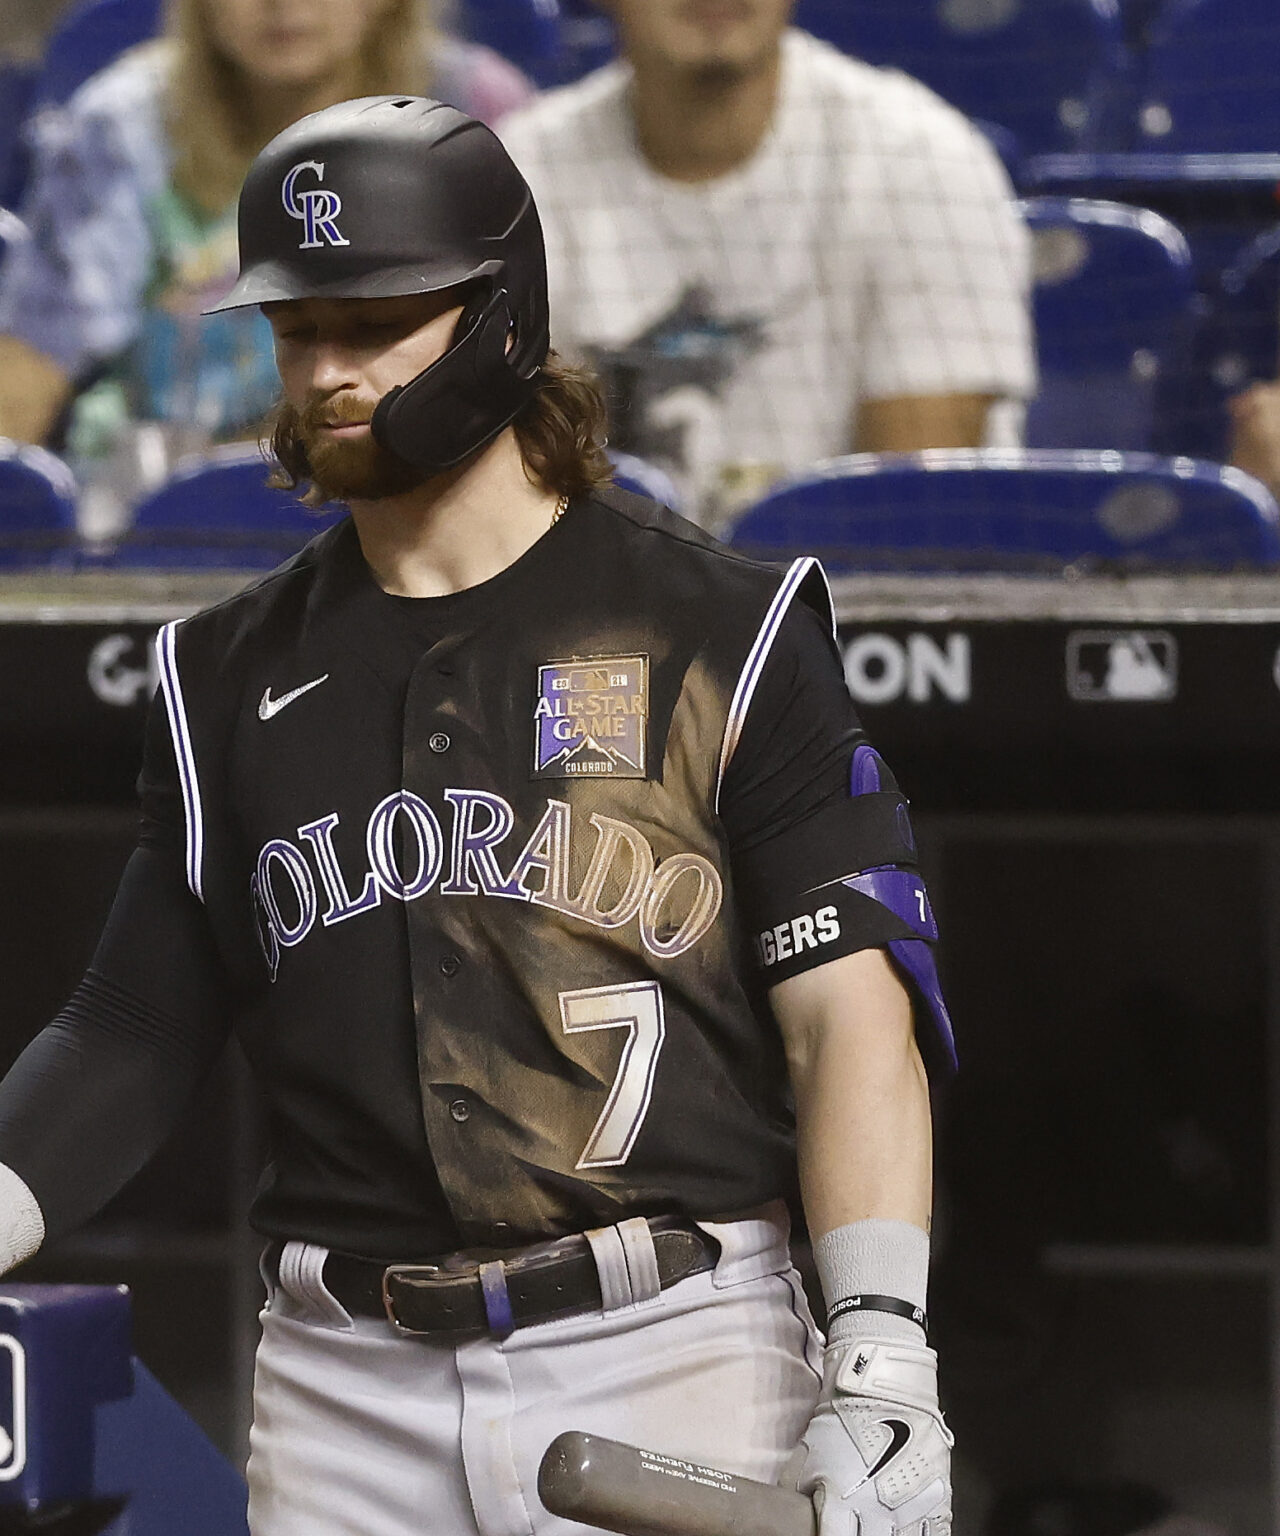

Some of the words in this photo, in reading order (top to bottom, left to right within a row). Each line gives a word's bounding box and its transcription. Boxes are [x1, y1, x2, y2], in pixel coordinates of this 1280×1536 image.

[281, 160, 350, 249] CR
[553, 717, 626, 740] GAME
[565, 761, 613, 773] COLORADO
[756, 904, 841, 967] GERS
[558, 980, 666, 1170] 7
[852, 1352, 869, 1377] NIKE
[639, 1450, 694, 1473] FUENTES
[697, 1466, 732, 1482] JOSH
